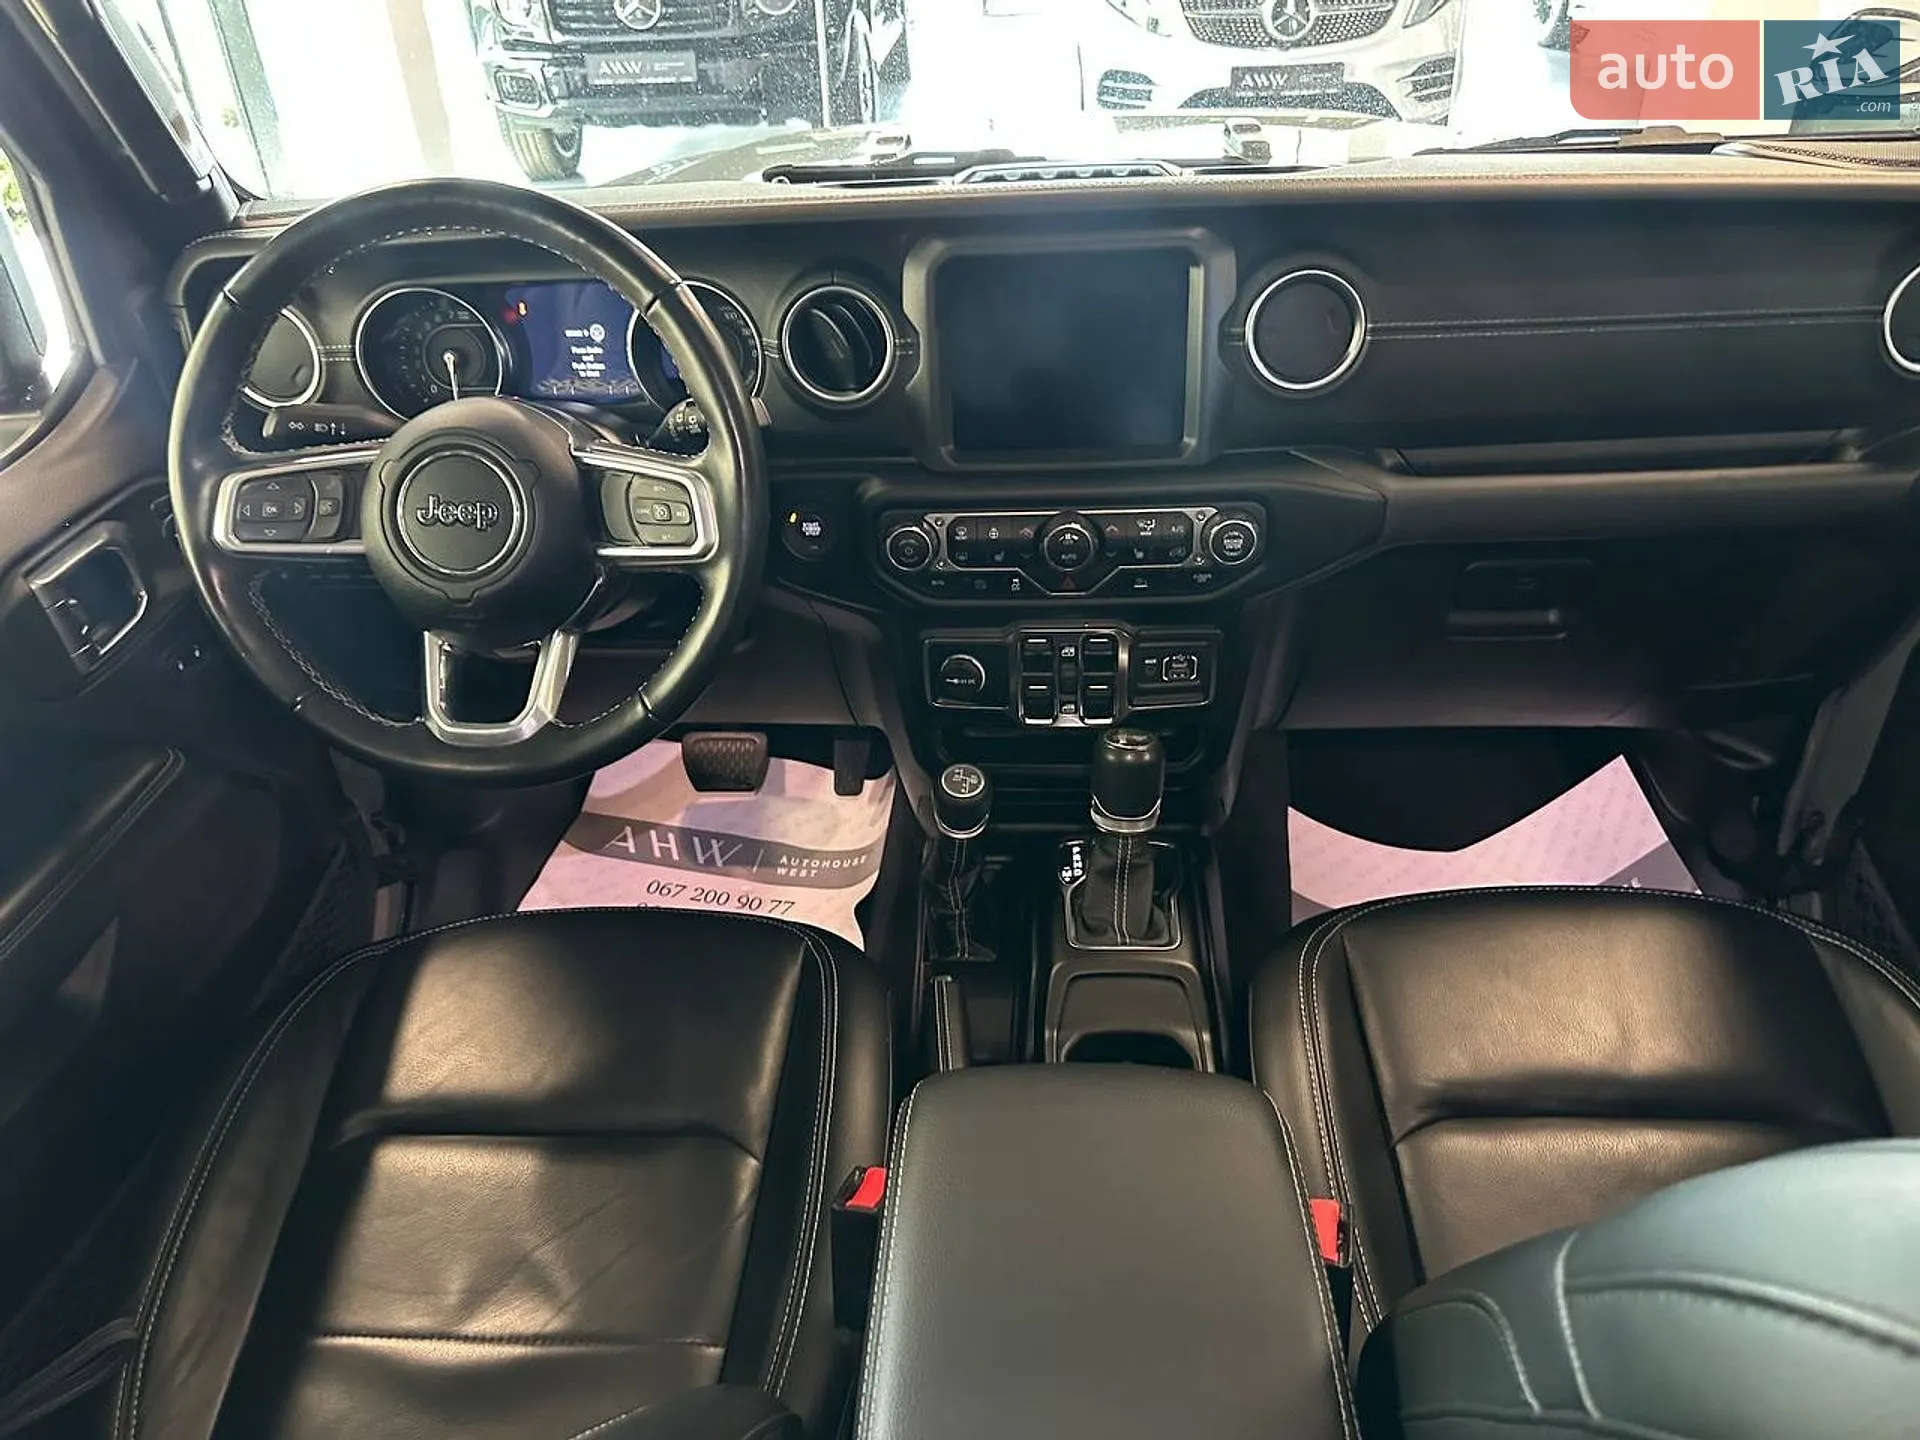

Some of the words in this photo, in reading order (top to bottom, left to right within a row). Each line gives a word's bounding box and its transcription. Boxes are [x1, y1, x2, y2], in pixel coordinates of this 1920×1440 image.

[416, 494, 499, 531] Jeep
[600, 825, 743, 867] AHW
[780, 854, 867, 868] AUTOHOUSE
[776, 867, 818, 877] WEST
[646, 879, 687, 898] 067
[689, 889, 731, 906] 200
[734, 895, 763, 912] 90
[769, 900, 797, 916] 77
